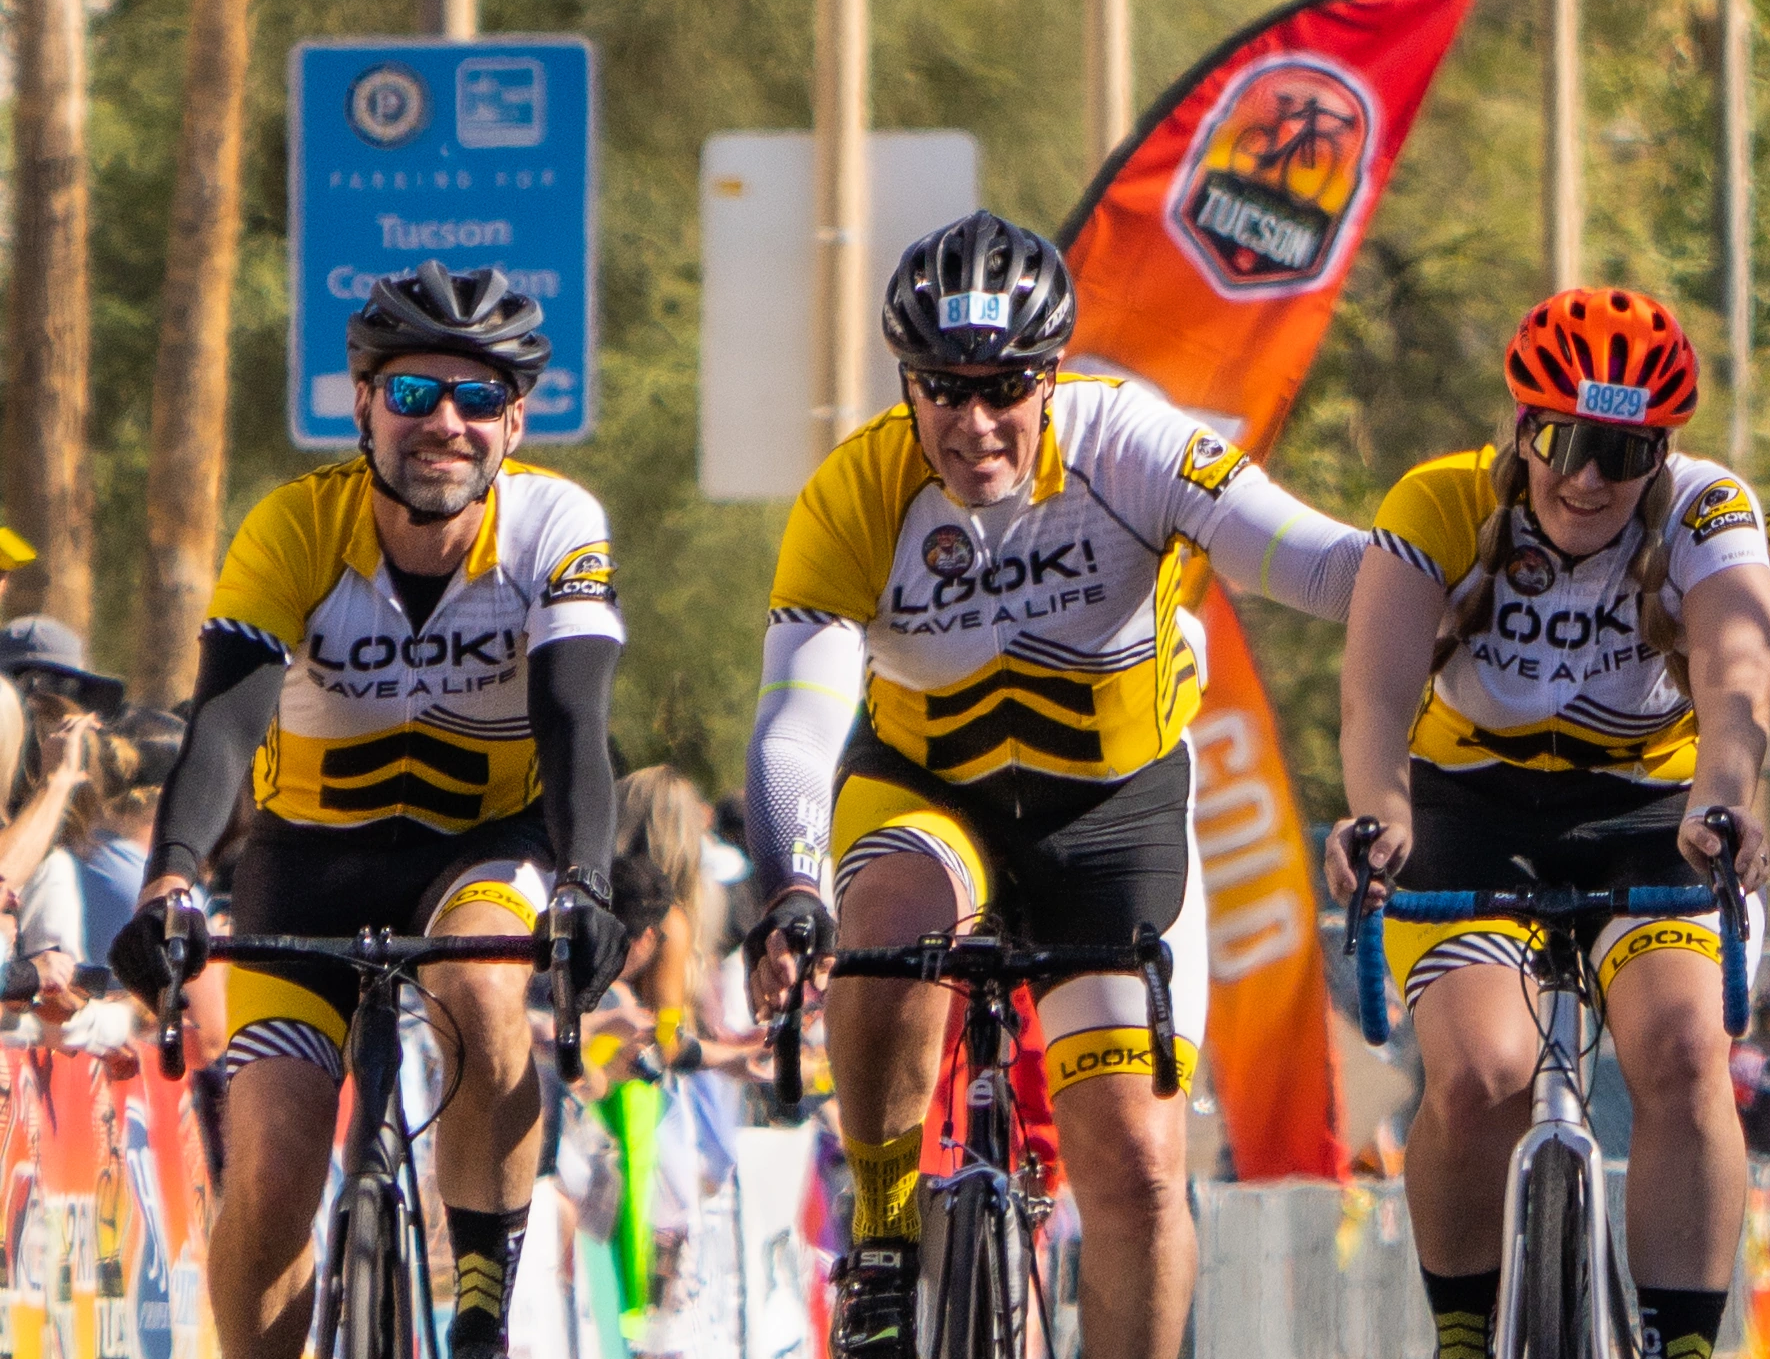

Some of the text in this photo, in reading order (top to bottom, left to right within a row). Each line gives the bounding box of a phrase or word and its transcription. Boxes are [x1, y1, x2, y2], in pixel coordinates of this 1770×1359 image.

[376, 213, 513, 249] Tucson
[1196, 186, 1314, 269] TUCSON
[1586, 384, 1642, 416] 8929
[891, 539, 1098, 613] LOOK!
[991, 605, 1017, 626] A
[1024, 583, 1106, 619] LIFE
[1498, 592, 1643, 650] OOK
[309, 628, 517, 672] LOOK!
[1473, 642, 1662, 684] AVE A LIFE
[307, 664, 517, 699] SAVE A LIFE
[1060, 1048, 1152, 1080] LOOK
